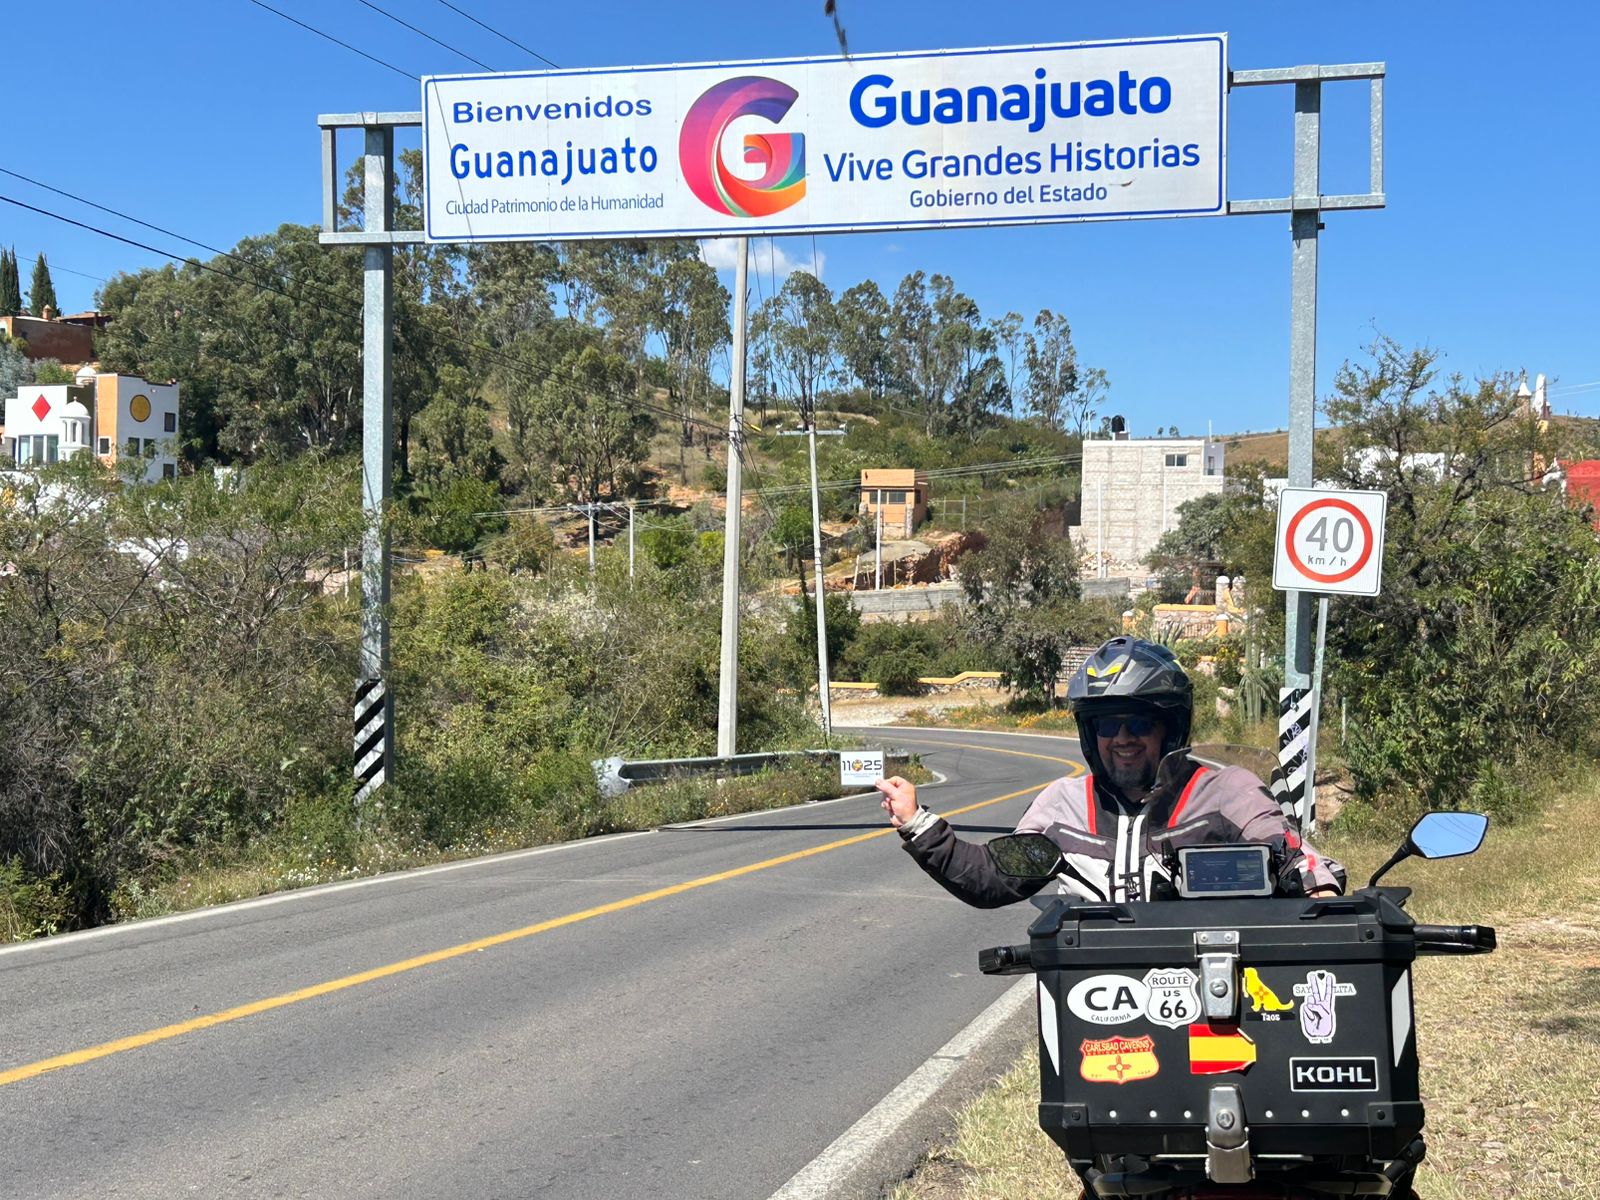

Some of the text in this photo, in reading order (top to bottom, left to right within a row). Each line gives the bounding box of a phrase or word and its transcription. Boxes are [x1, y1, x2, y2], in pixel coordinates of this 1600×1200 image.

[453, 95, 653, 123] Bienvenidos
[849, 67, 1172, 133] Guanajuato
[450, 136, 658, 185] Guanajuato
[823, 137, 1201, 183] Vive Grandes Historias
[446, 192, 664, 215] Ciudad Patrimonio de la Humanidad
[909, 182, 1108, 209] Gobierno del Estado
[1305, 516, 1354, 553] 40
[1307, 555, 1347, 567] km/h
[1152, 976, 1189, 986] ROUTE
[1084, 986, 1139, 1011] CA
[1163, 990, 1181, 998] US
[1090, 1013, 1132, 1022] CALIFORNIA
[1160, 1000, 1187, 1019] 66
[1261, 1013, 1281, 1021] Taos
[1085, 1039, 1150, 1053] CARLSBAD CAVERNS
[1297, 1066, 1372, 1083] KOHL
